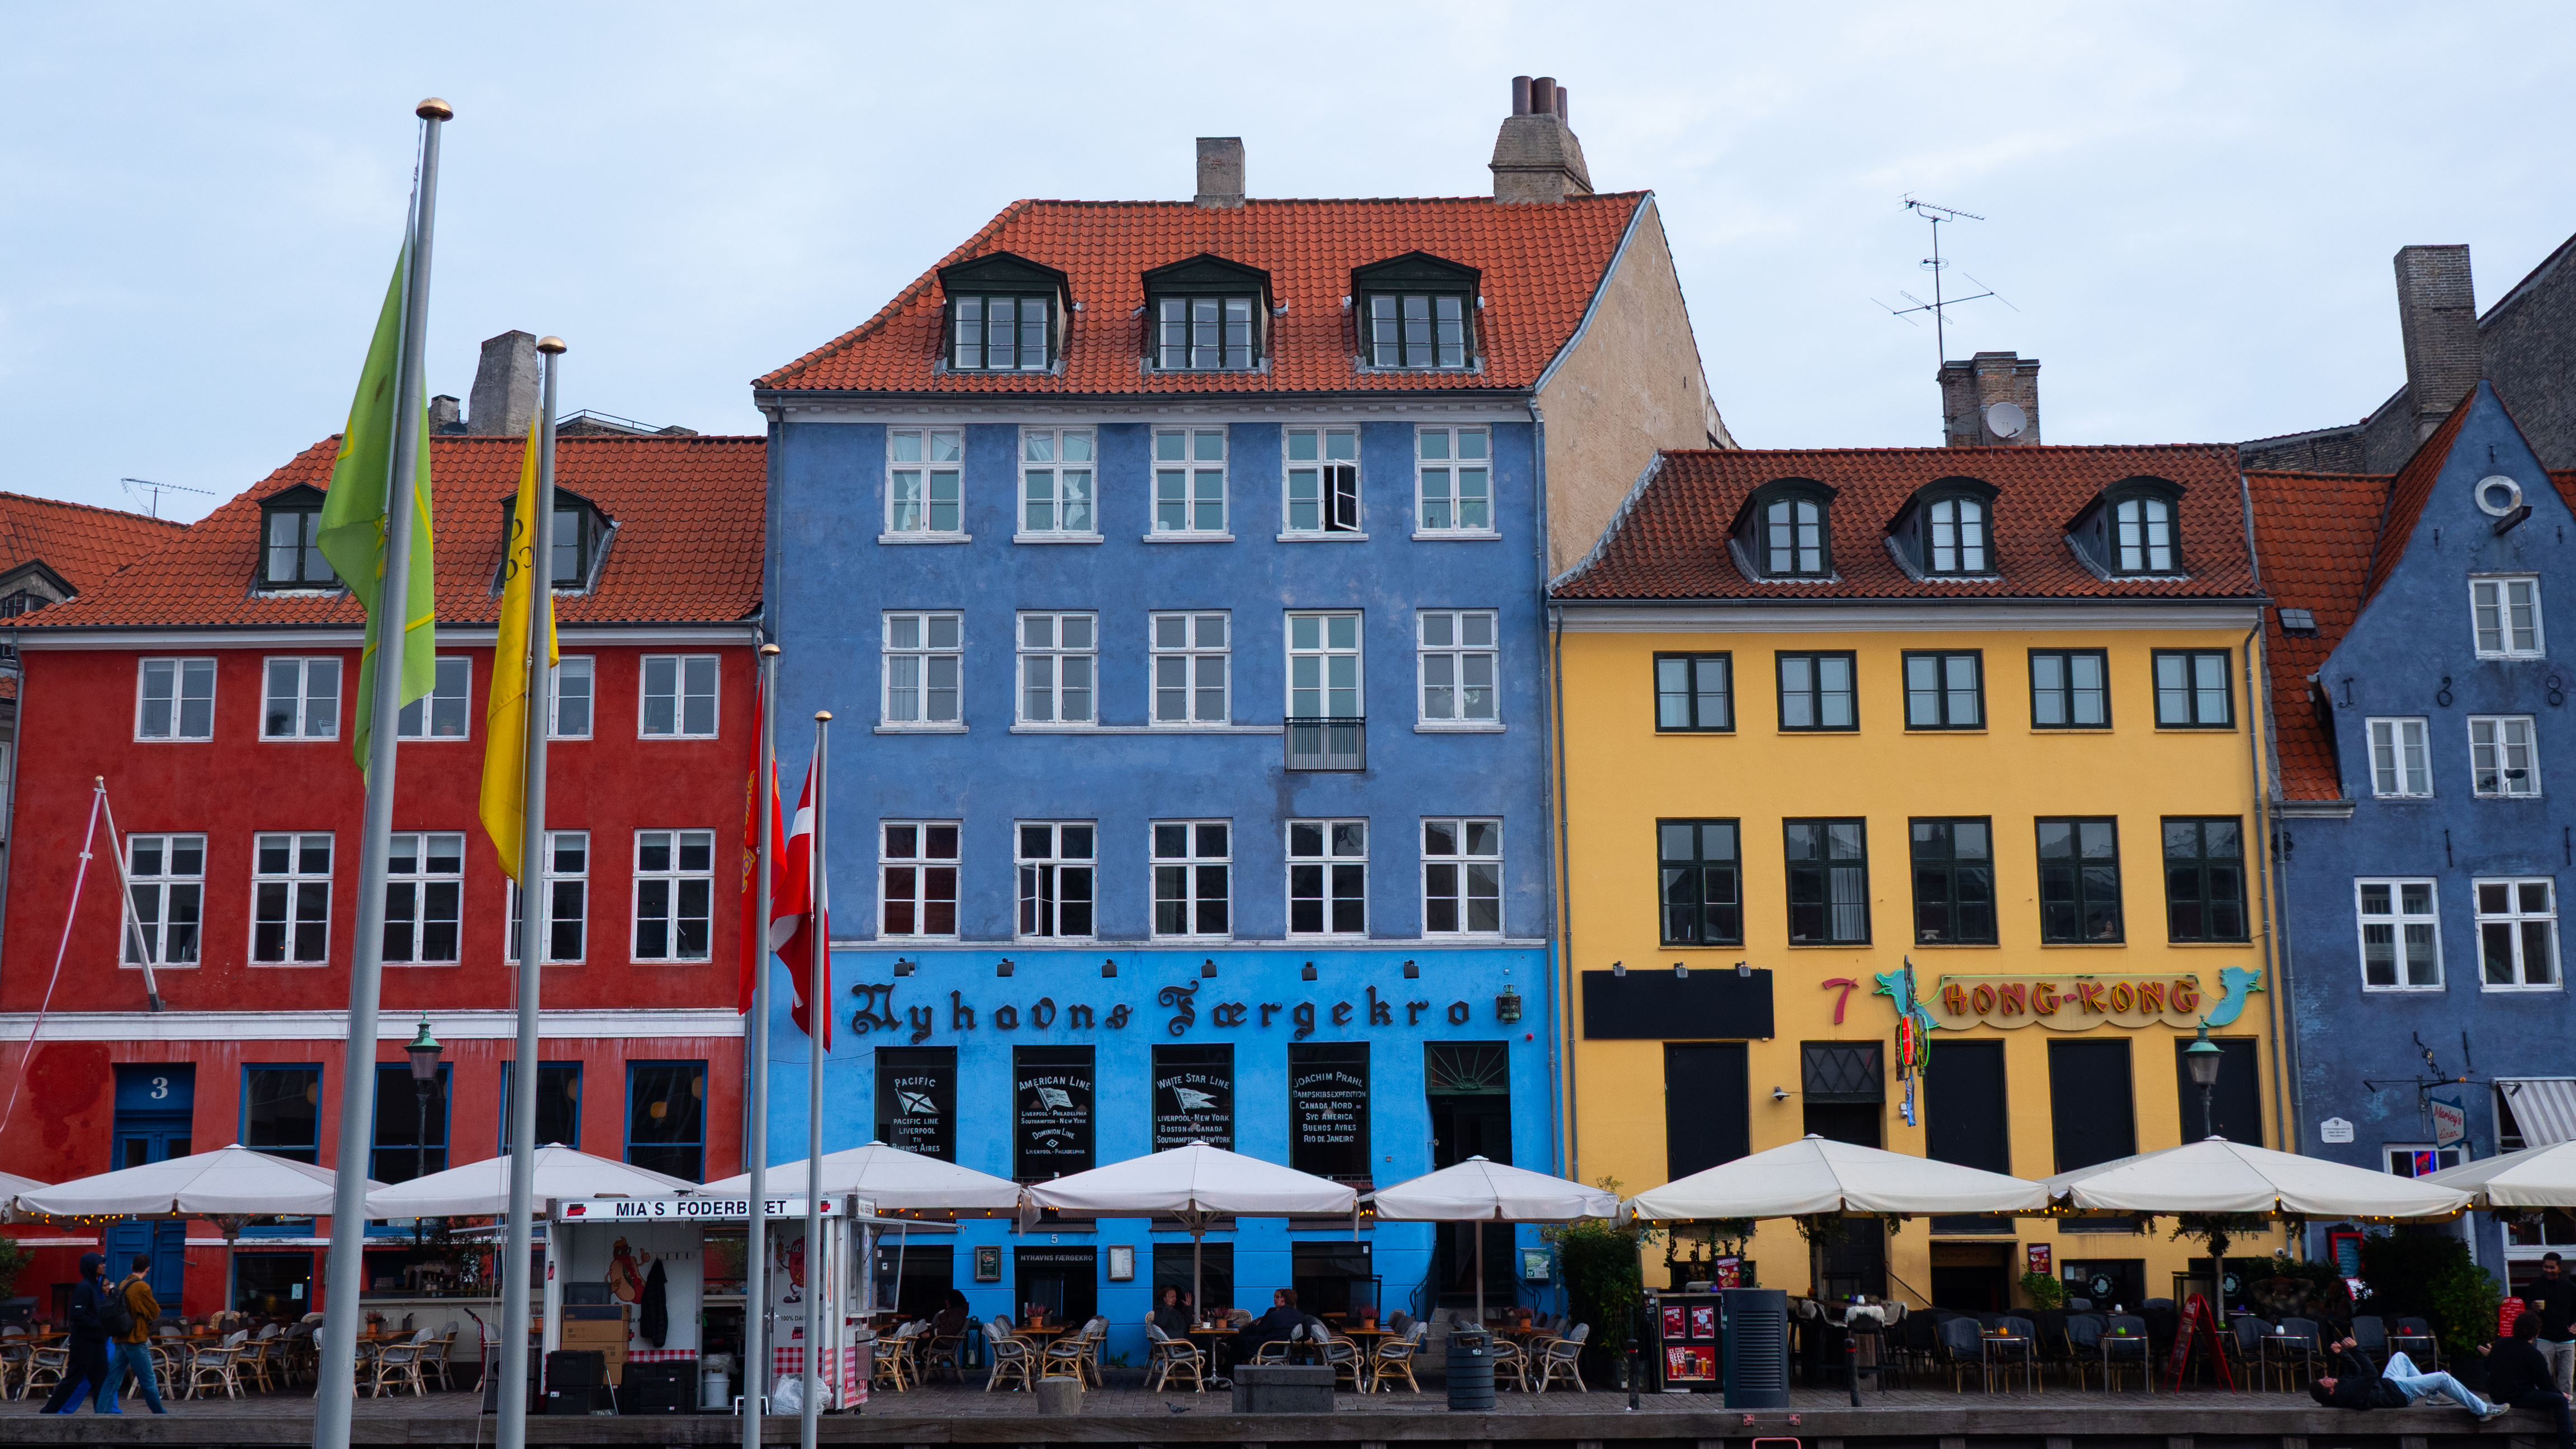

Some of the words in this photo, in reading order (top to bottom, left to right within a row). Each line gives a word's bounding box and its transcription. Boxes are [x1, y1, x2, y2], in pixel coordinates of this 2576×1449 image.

[1822, 977, 1860, 1025] 7
[1943, 980, 2200, 1016] HONG-KONG
[851, 983, 1134, 1044] Nyhavns
[1158, 979, 1470, 1040] Færgekro
[150, 1077, 168, 1099] 3
[894, 1077, 936, 1088] PACIFIC
[1019, 1076, 1066, 1091] AMERICAN
[1069, 1076, 1091, 1091] LINE
[1157, 1076, 1183, 1089] WHITE
[1186, 1073, 1206, 1083] STAR
[1210, 1076, 1230, 1090] LINE
[1294, 1073, 1332, 1088] JOACHIM
[1336, 1072, 1362, 1087] PRAHL
[2434, 1105, 2462, 1127] Marley's
[1032, 1129, 1060, 1140] DOMINION
[1062, 1128, 1075, 1139] LINE
[920, 1143, 940, 1152] AIRES
[677, 1200, 787, 1216] FODERBÆT
[1051, 1234, 1058, 1244] 5
[1669, 1352, 1685, 1362] BEER
